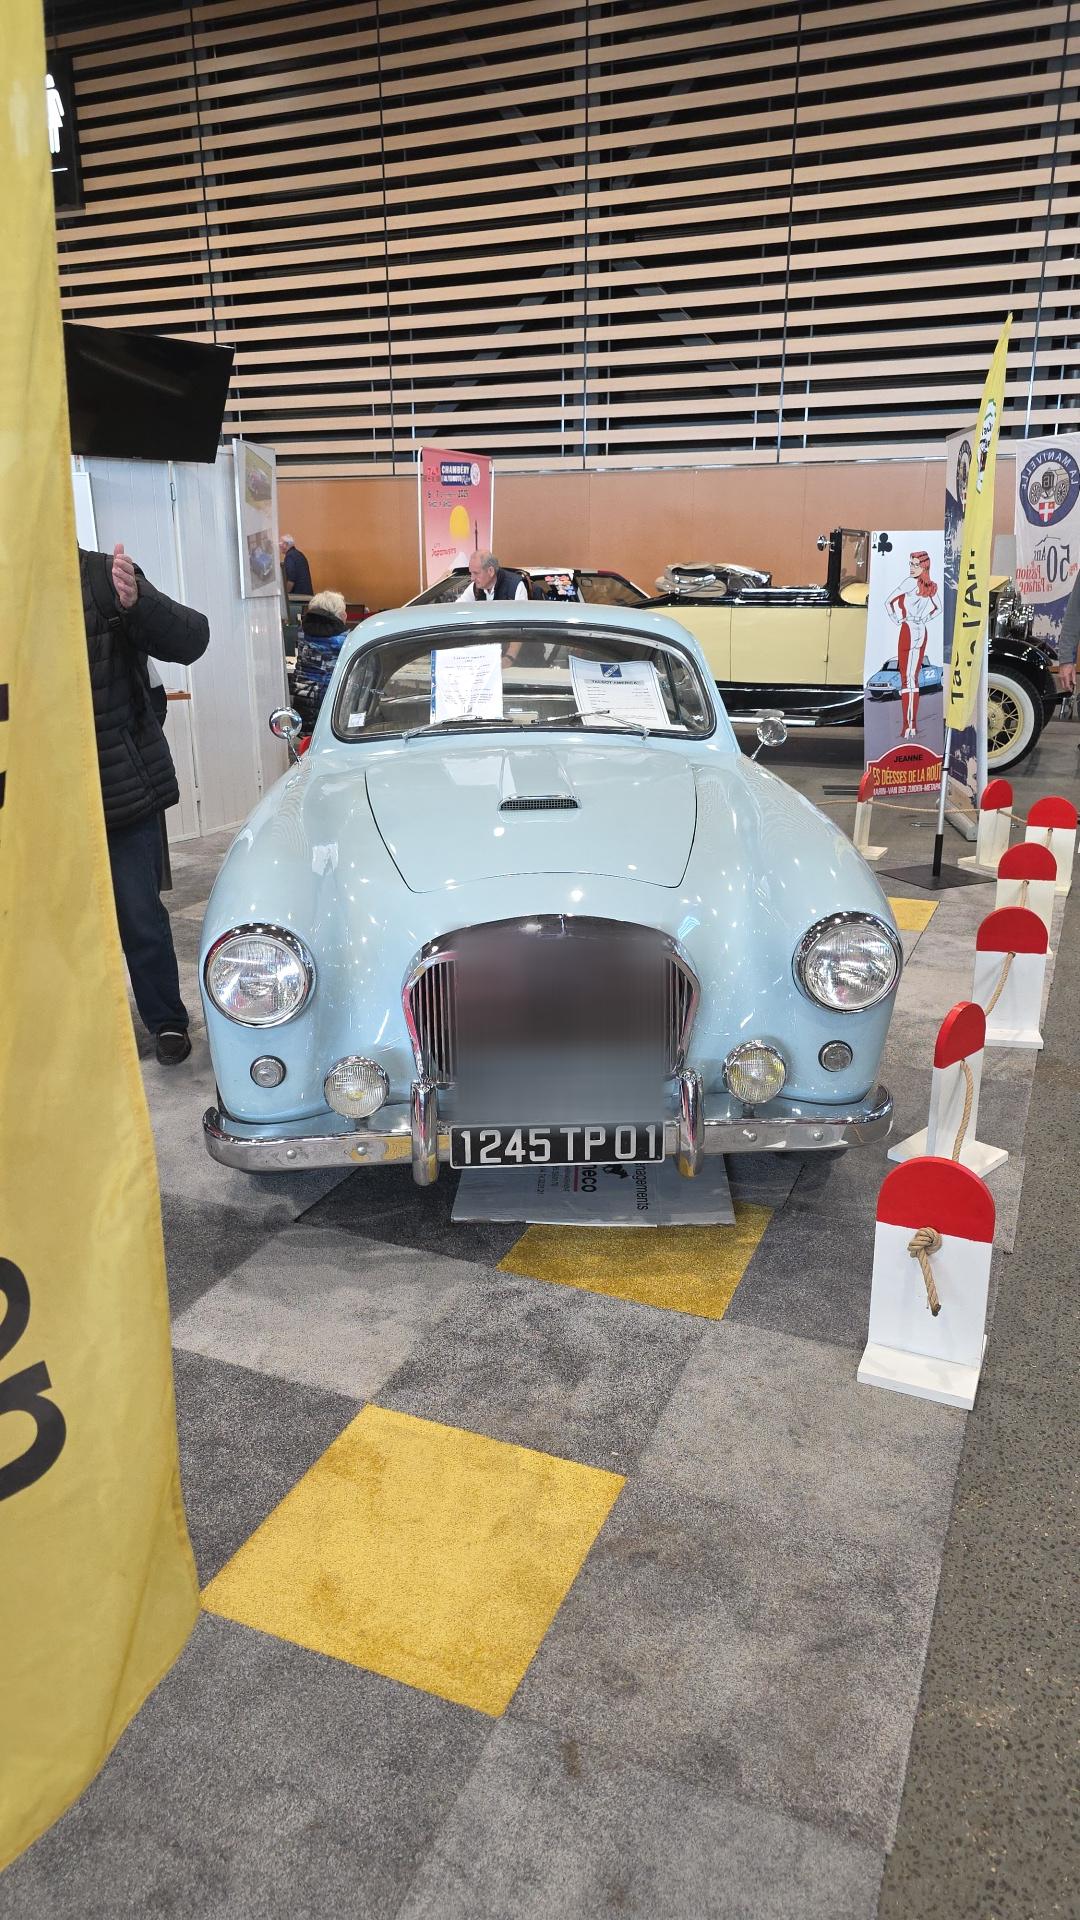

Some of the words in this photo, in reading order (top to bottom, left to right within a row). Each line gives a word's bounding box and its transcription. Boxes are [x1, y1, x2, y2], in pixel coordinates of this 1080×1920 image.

[924, 670, 936, 679] 22
[893, 754, 924, 763] JEANNE
[881, 766, 908, 786] DÉESSES
[908, 769, 917, 783] DE
[917, 768, 927, 783] LA
[926, 762, 943, 781] ROUT
[460, 1128, 551, 1165] 1245
[559, 1126, 606, 1161] TP
[614, 1125, 656, 1159] 01
